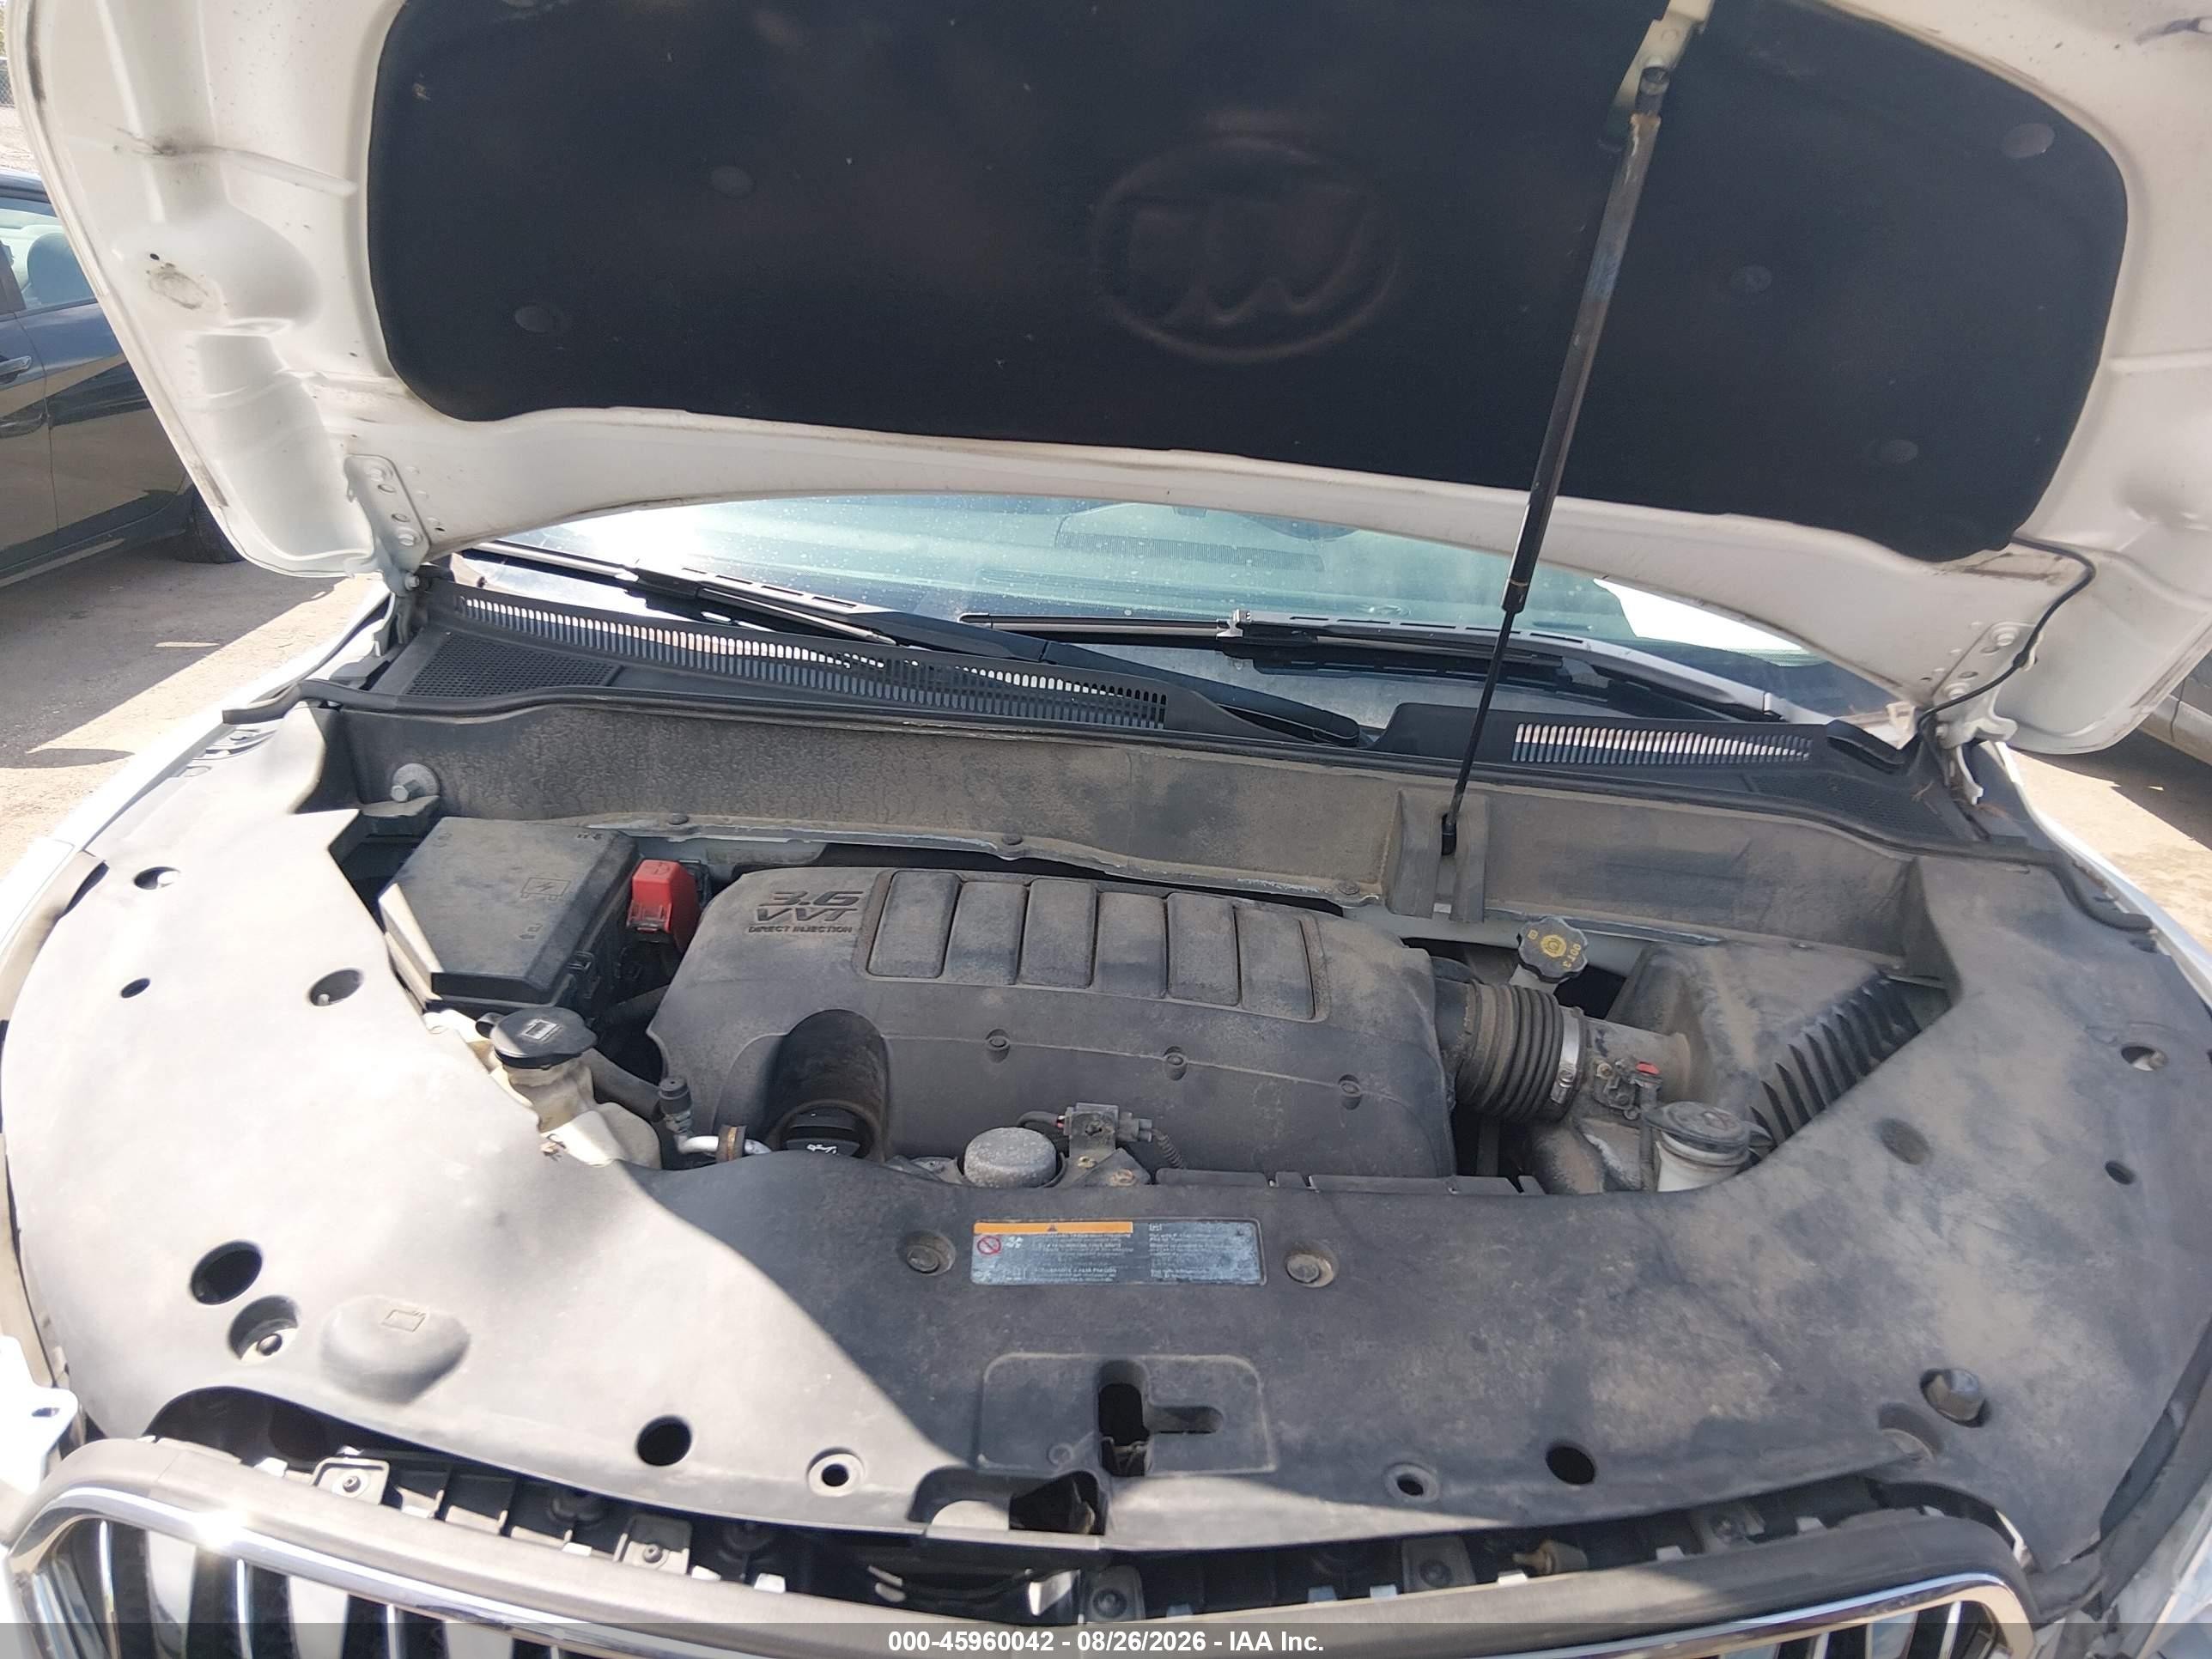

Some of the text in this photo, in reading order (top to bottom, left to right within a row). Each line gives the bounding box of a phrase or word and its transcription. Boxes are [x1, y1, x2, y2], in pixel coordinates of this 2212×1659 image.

[758, 890, 864, 906] 3.6
[757, 908, 858, 921] VVT
[1567, 944, 1581, 962] DOT
